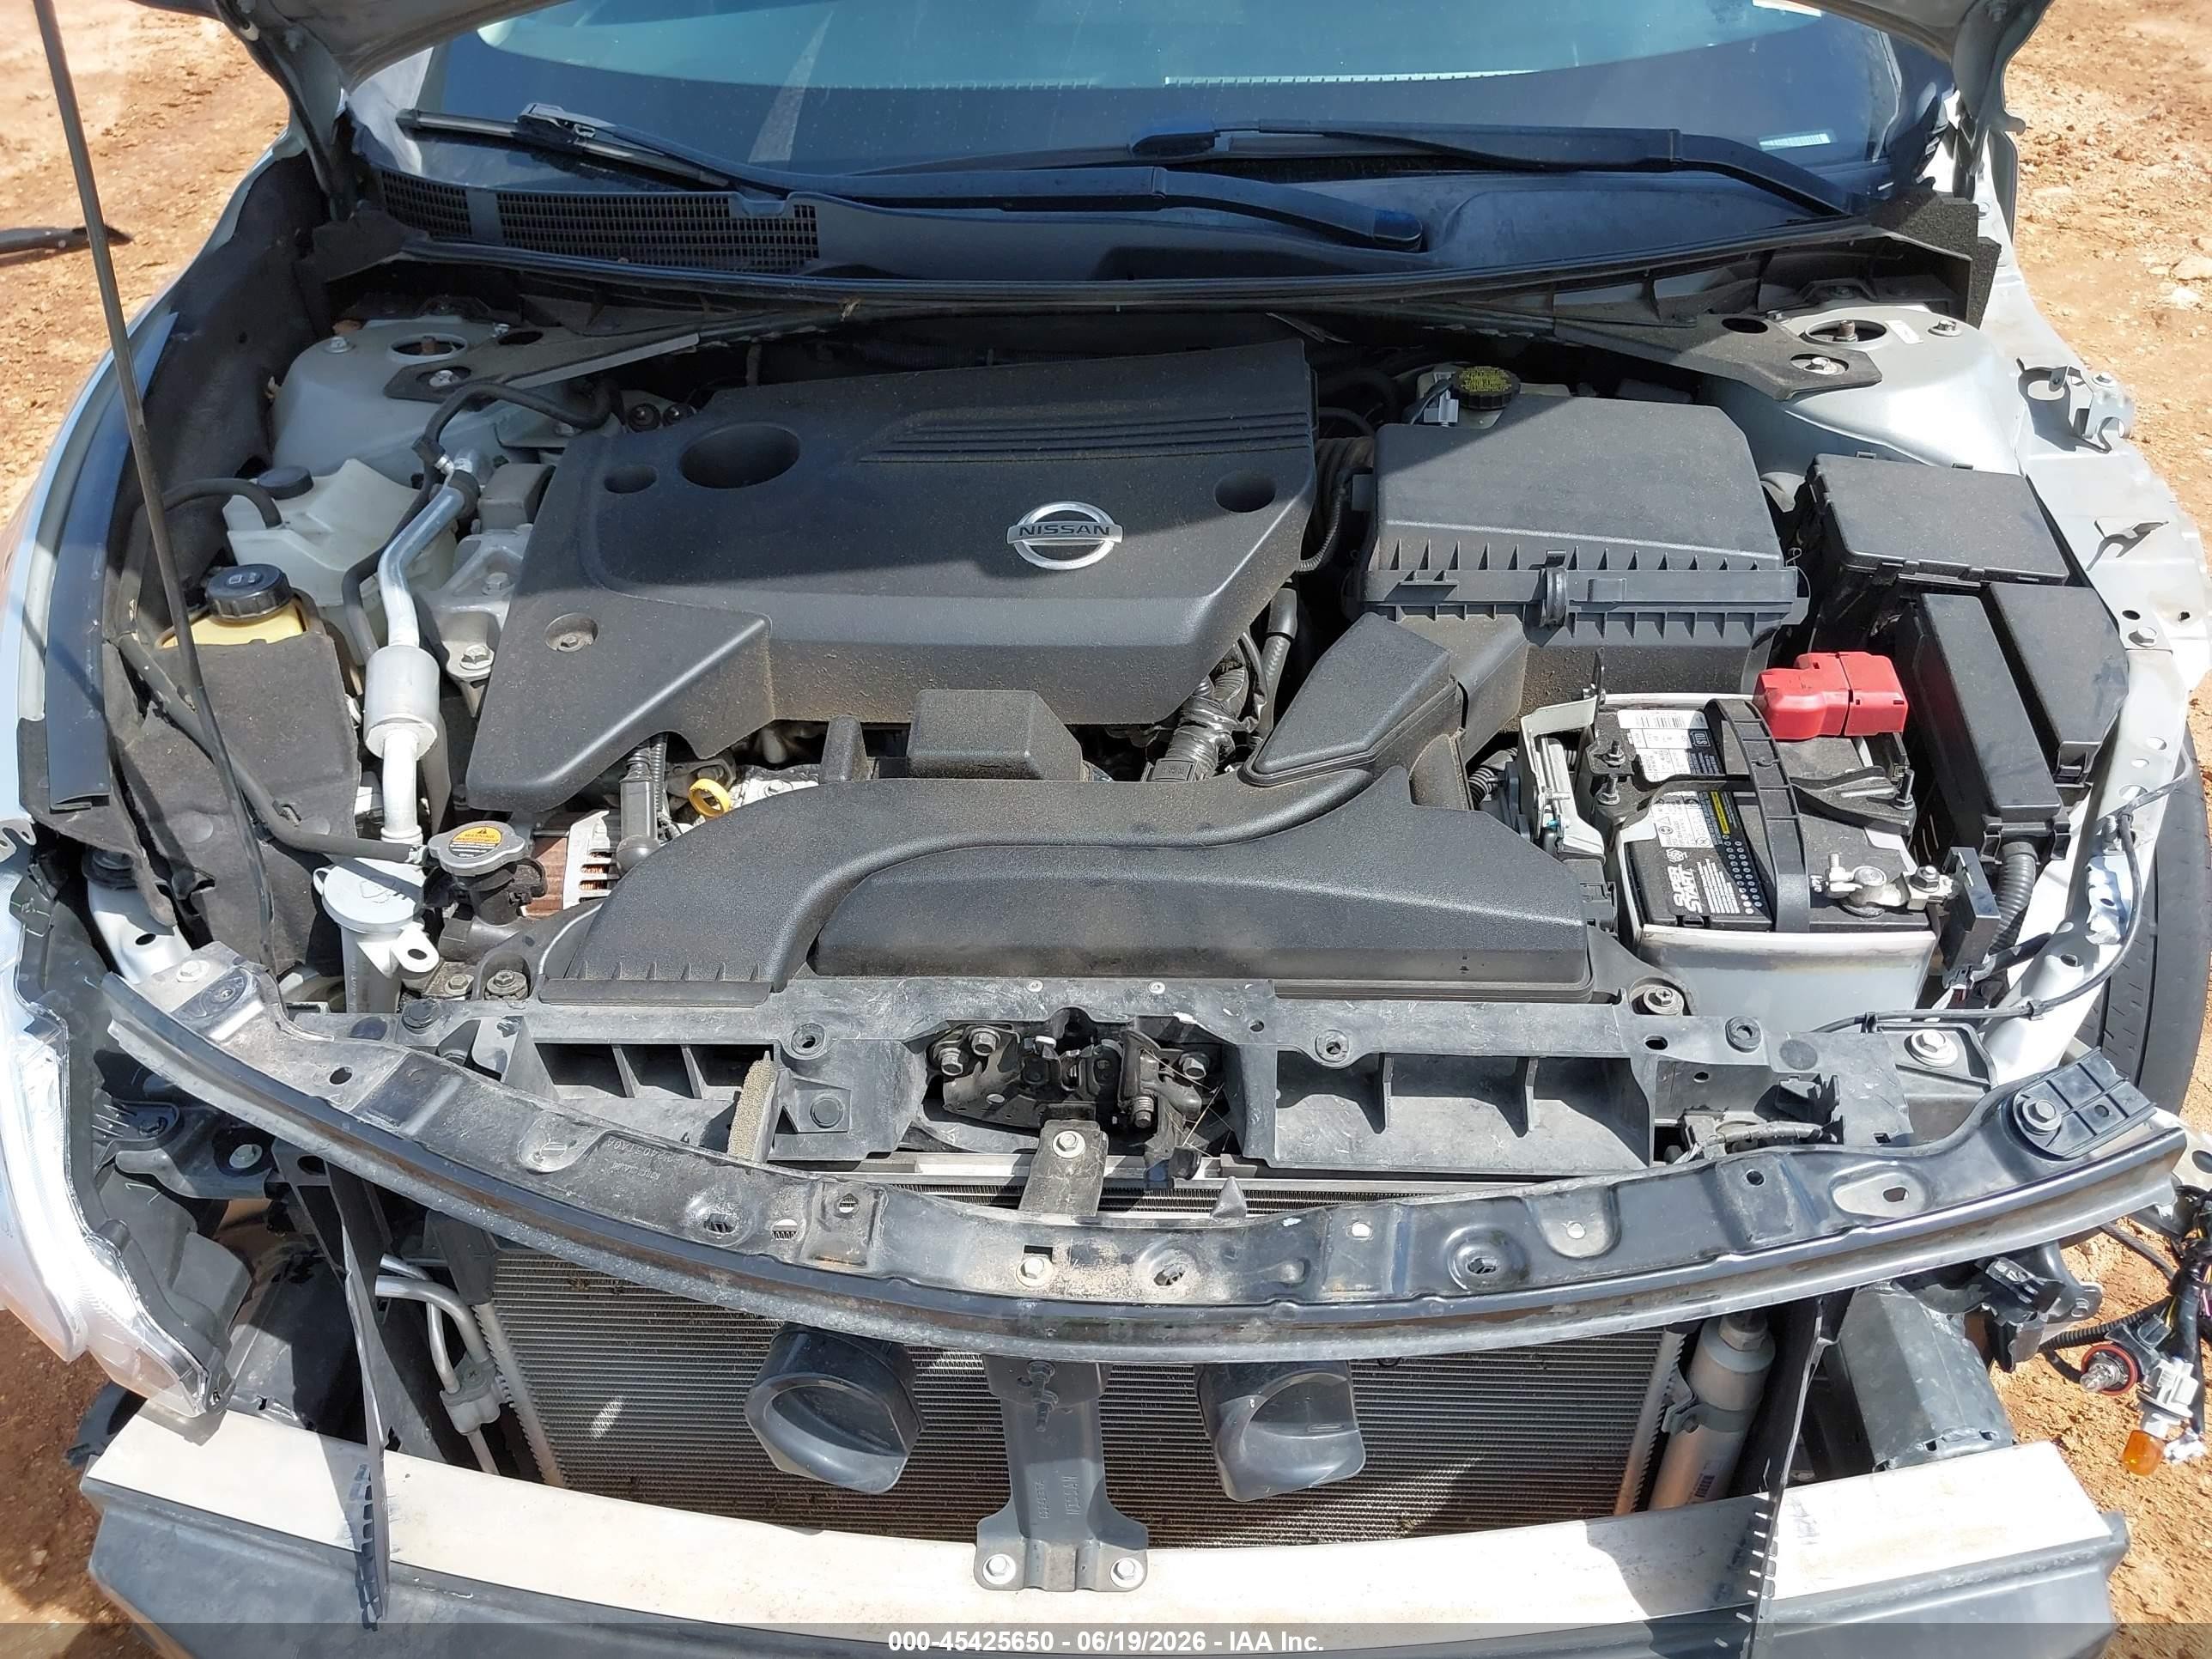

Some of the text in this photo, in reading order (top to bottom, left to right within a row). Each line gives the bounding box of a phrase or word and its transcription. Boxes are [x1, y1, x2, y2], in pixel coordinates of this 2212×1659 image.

[1018, 525, 1109, 537] NISSAN
[1667, 866, 1685, 907] SUPER
[1678, 864, 1703, 914] START
